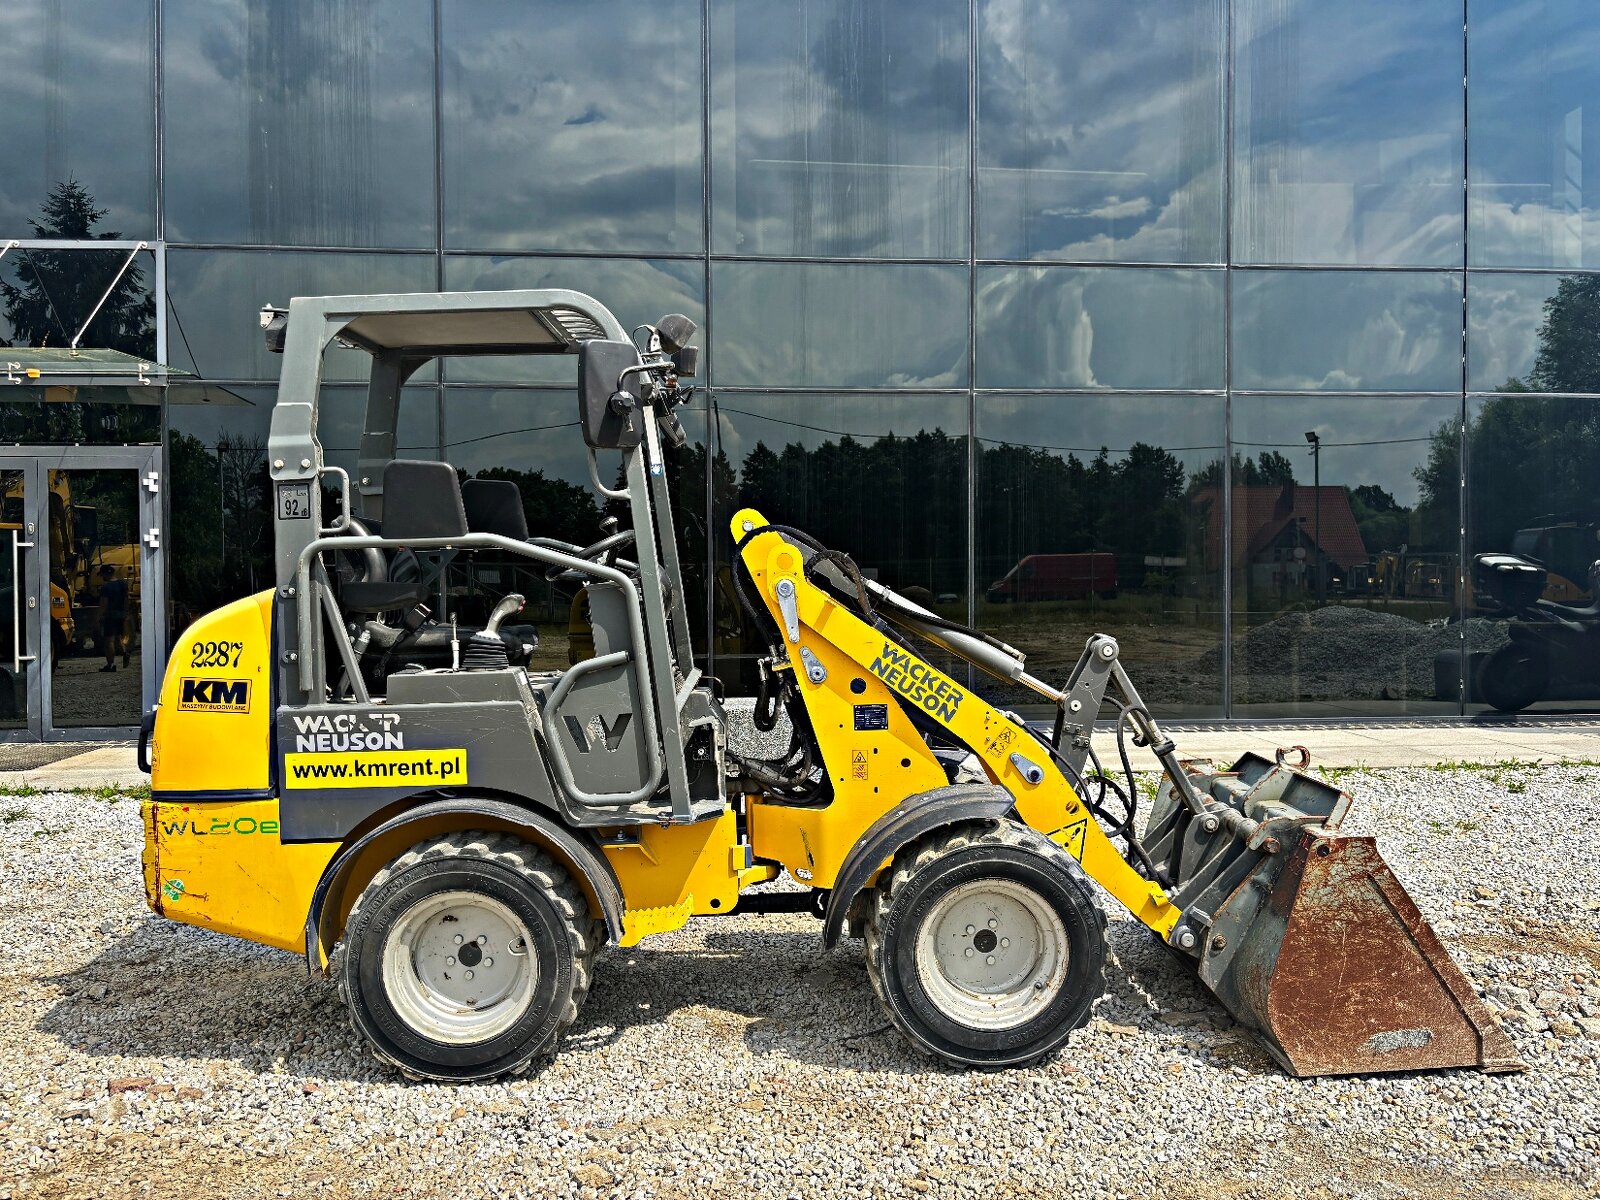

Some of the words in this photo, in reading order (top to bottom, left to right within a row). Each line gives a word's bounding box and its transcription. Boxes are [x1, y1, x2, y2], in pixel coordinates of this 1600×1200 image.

[285, 500, 299, 516] 92
[191, 641, 243, 668] 2287
[882, 641, 964, 709] WACKER
[182, 680, 248, 705] KM
[870, 657, 957, 723] NEUSON
[296, 732, 404, 753] NEUSON
[293, 757, 460, 780] www.kmrent.pl
